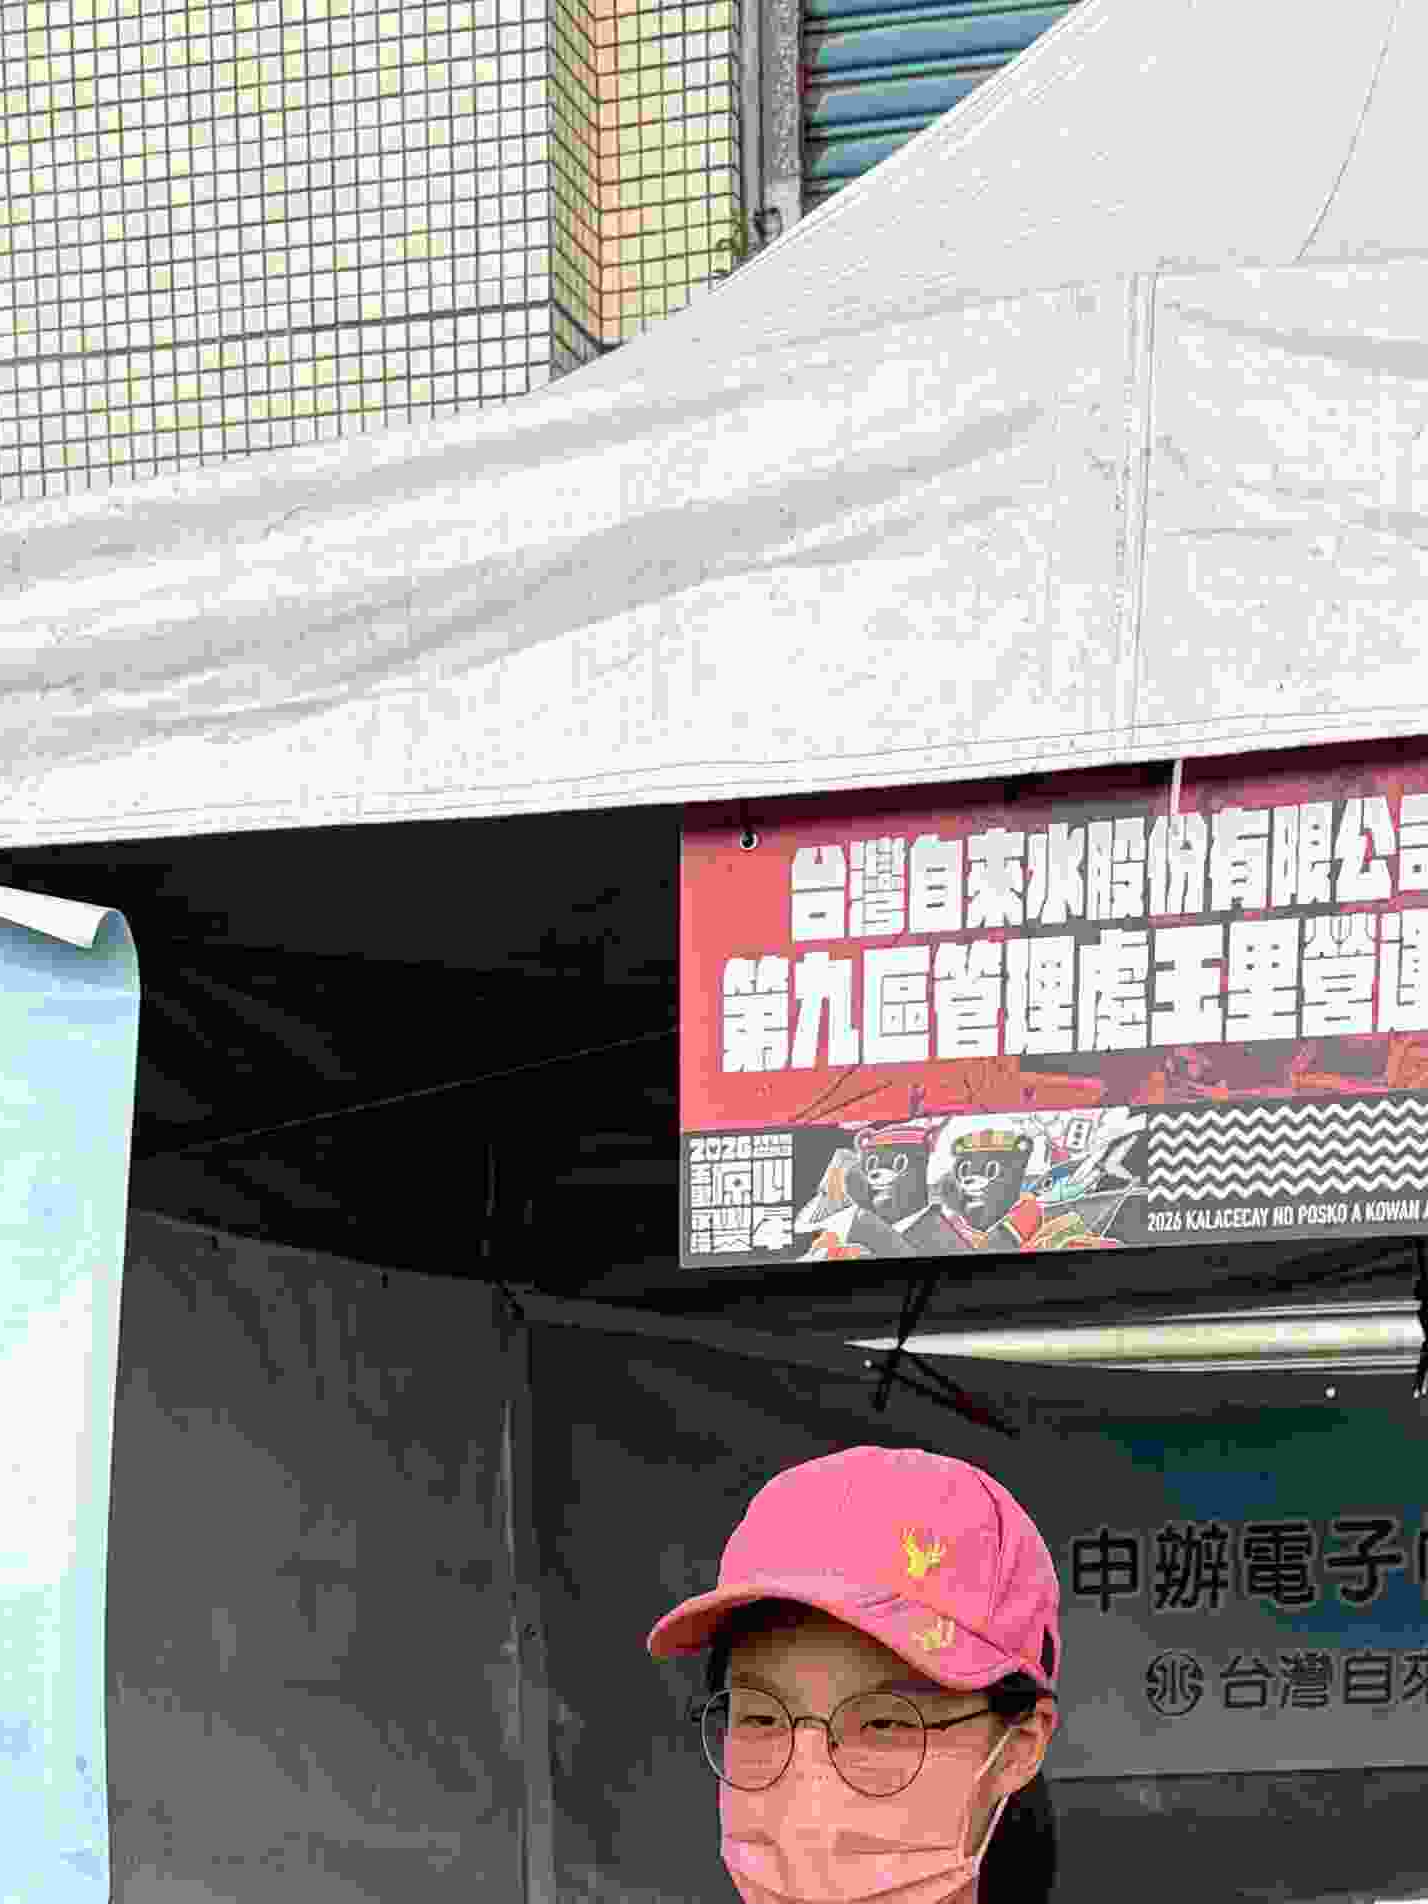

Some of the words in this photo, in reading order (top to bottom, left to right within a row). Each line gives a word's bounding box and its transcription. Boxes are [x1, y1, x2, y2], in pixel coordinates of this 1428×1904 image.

[1147, 1210, 1183, 1232] 2026
[1273, 1205, 1293, 1226] NO
[1298, 1203, 1348, 1225] POSKO
[1352, 1203, 1362, 1223] A
[1369, 1200, 1420, 1222] KOWAN
